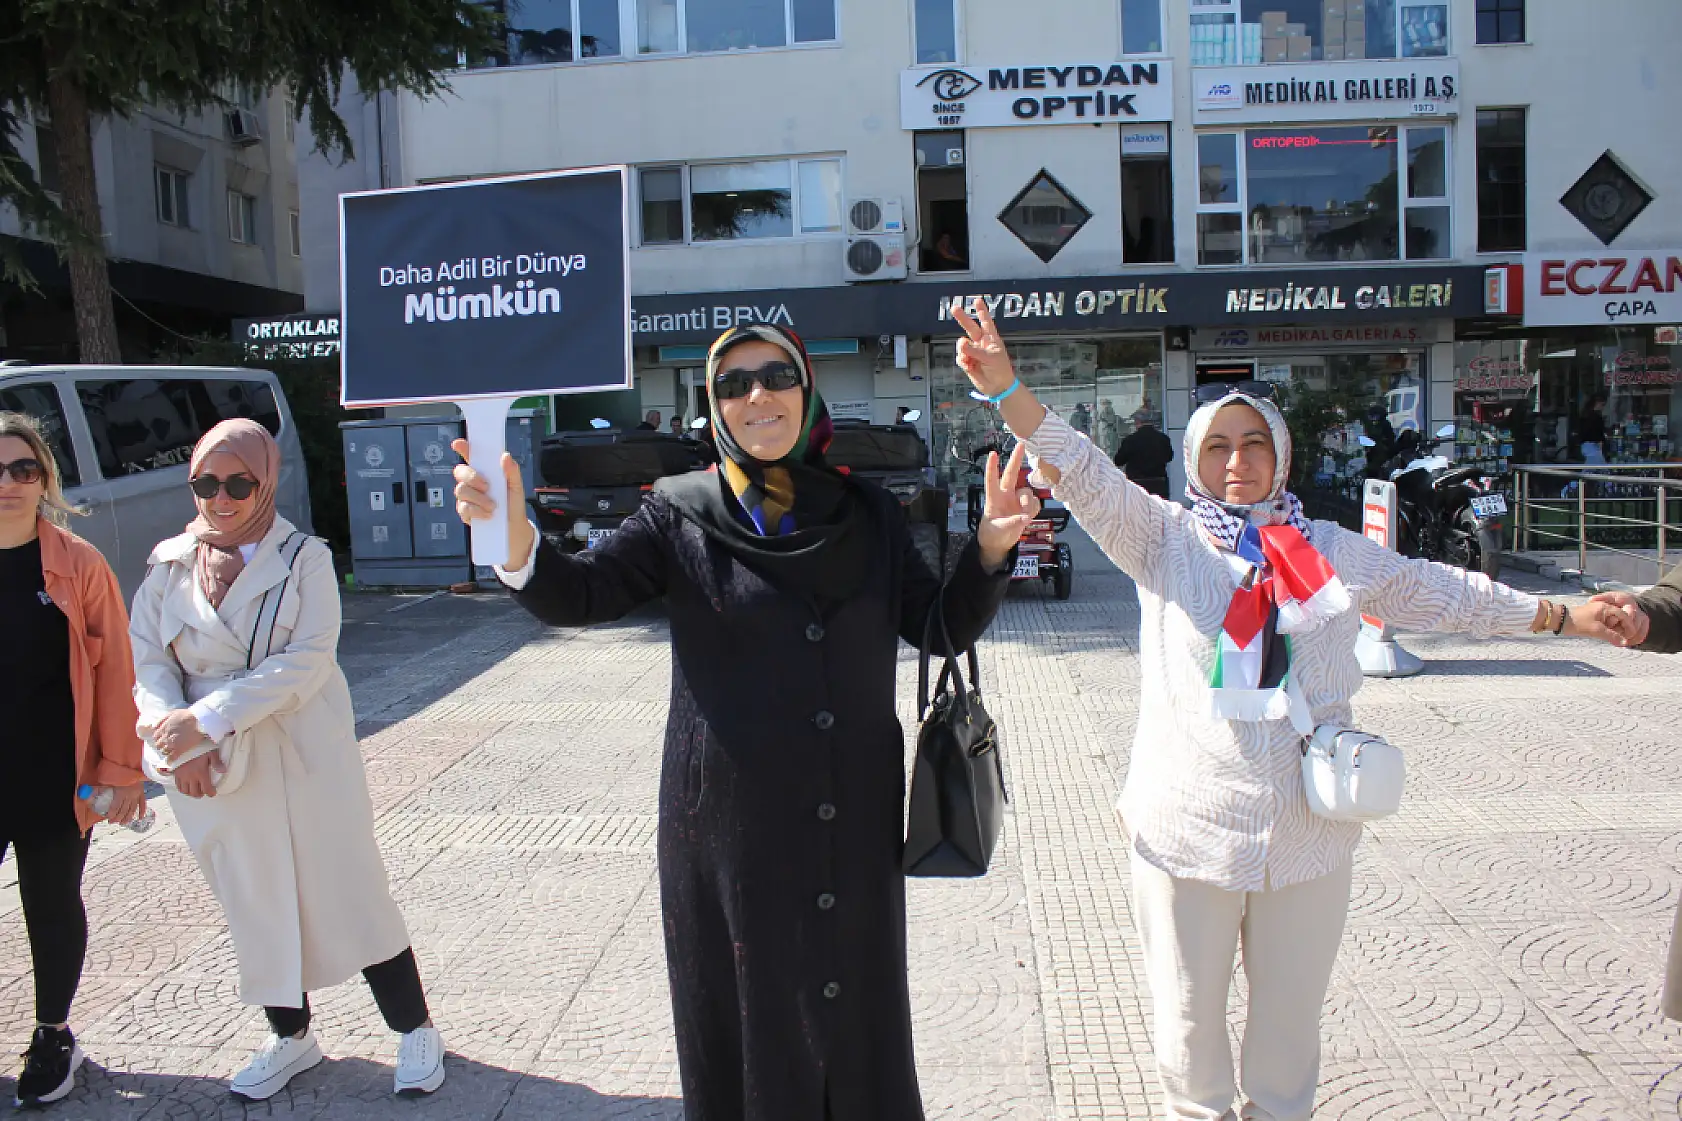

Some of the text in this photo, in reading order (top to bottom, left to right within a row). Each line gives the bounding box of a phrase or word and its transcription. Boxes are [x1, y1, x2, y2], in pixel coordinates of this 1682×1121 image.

[988, 63, 1158, 90] MEYDAN
[1245, 73, 1458, 104] MEDİKAL GALERİ A.Ş.
[1012, 90, 1138, 119] OPTİK
[380, 252, 586, 287] Daha Adil Bir Dünya
[404, 279, 561, 324] Mümkün
[1075, 283, 1169, 315] OPTİK
[1225, 278, 1452, 313] MEDİKAL GALERİ
[1604, 300, 1657, 320] ÇAPA
[248, 319, 339, 339] ORTAKLAR
[1257, 328, 1329, 343] MEDİKAL
